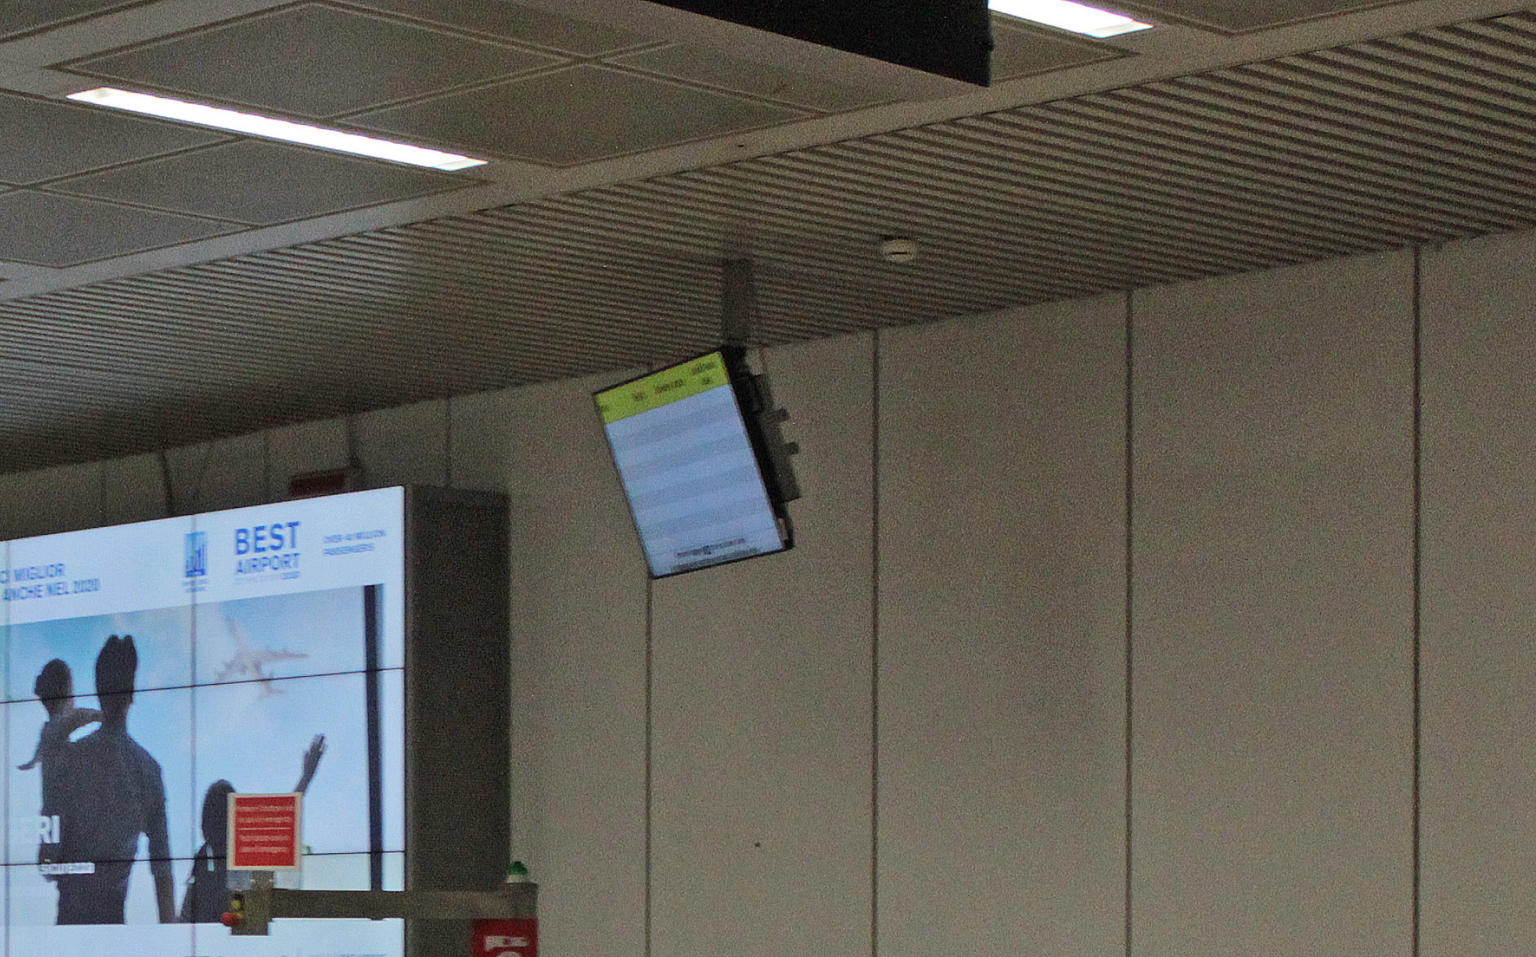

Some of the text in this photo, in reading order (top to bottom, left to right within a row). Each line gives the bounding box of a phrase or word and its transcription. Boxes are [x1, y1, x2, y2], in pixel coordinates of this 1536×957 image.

[235, 521, 301, 555] BEST
[14, 562, 65, 582] MIGLIOR
[235, 553, 301, 574] AIRPORT
[2, 584, 44, 601] ANCHE
[47, 581, 70, 597] NEL
